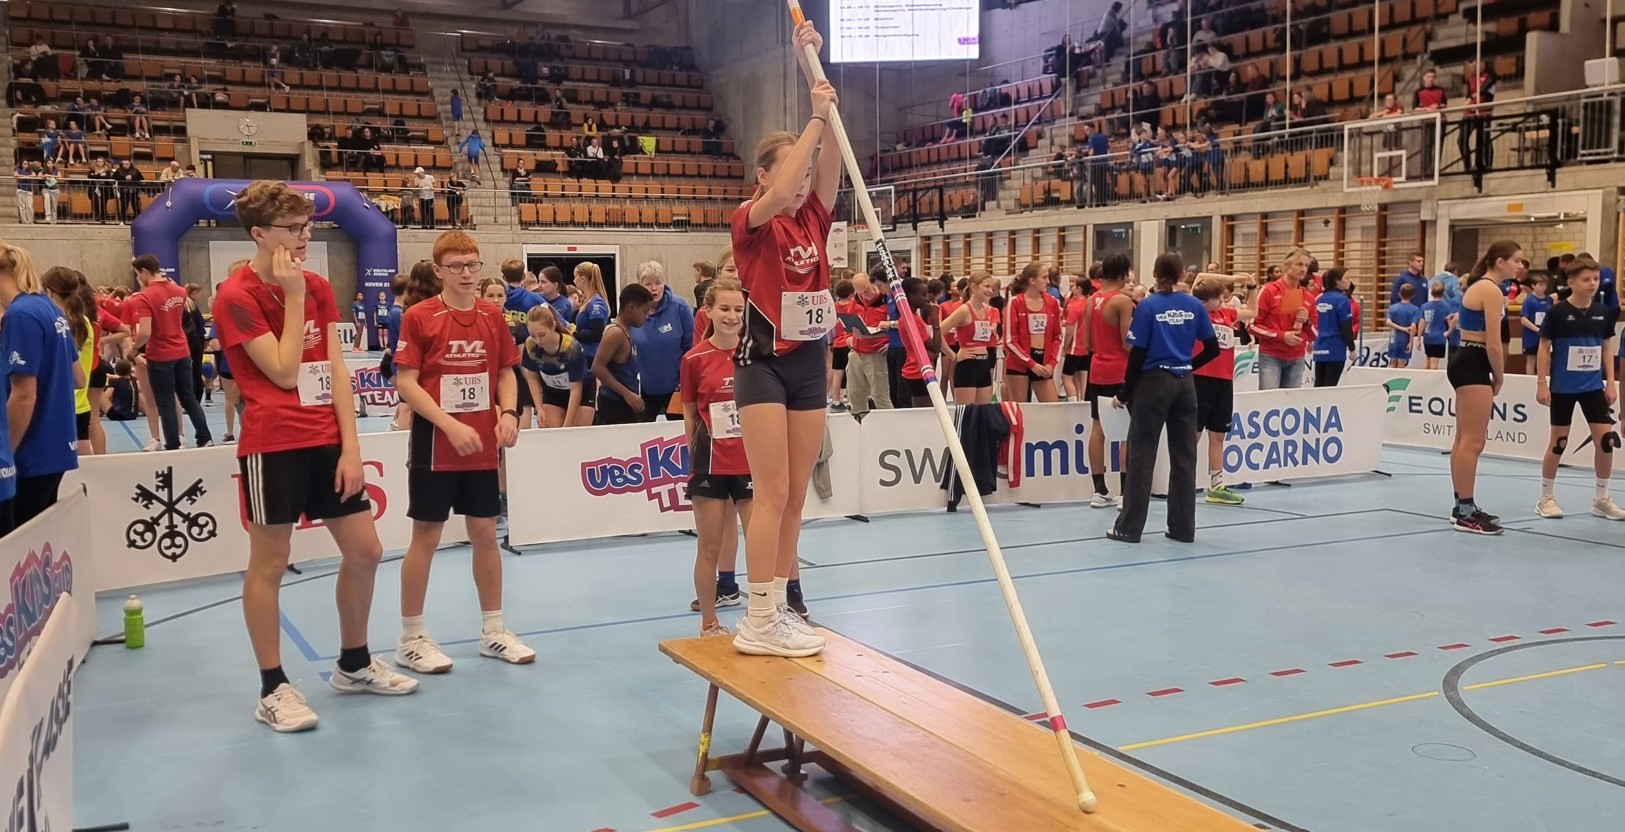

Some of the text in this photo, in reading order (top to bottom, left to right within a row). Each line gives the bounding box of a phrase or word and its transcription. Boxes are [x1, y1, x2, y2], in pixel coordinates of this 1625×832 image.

[811, 293, 828, 305] UBS
[806, 308, 824, 325] 18
[448, 340, 487, 353] TVL
[318, 376, 331, 391] 18
[464, 376, 482, 386] UBS
[460, 387, 476, 401] 18
[1225, 405, 1343, 442] ASCONA
[1222, 436, 1343, 474] OCARNO
[587, 462, 645, 490] UBS
